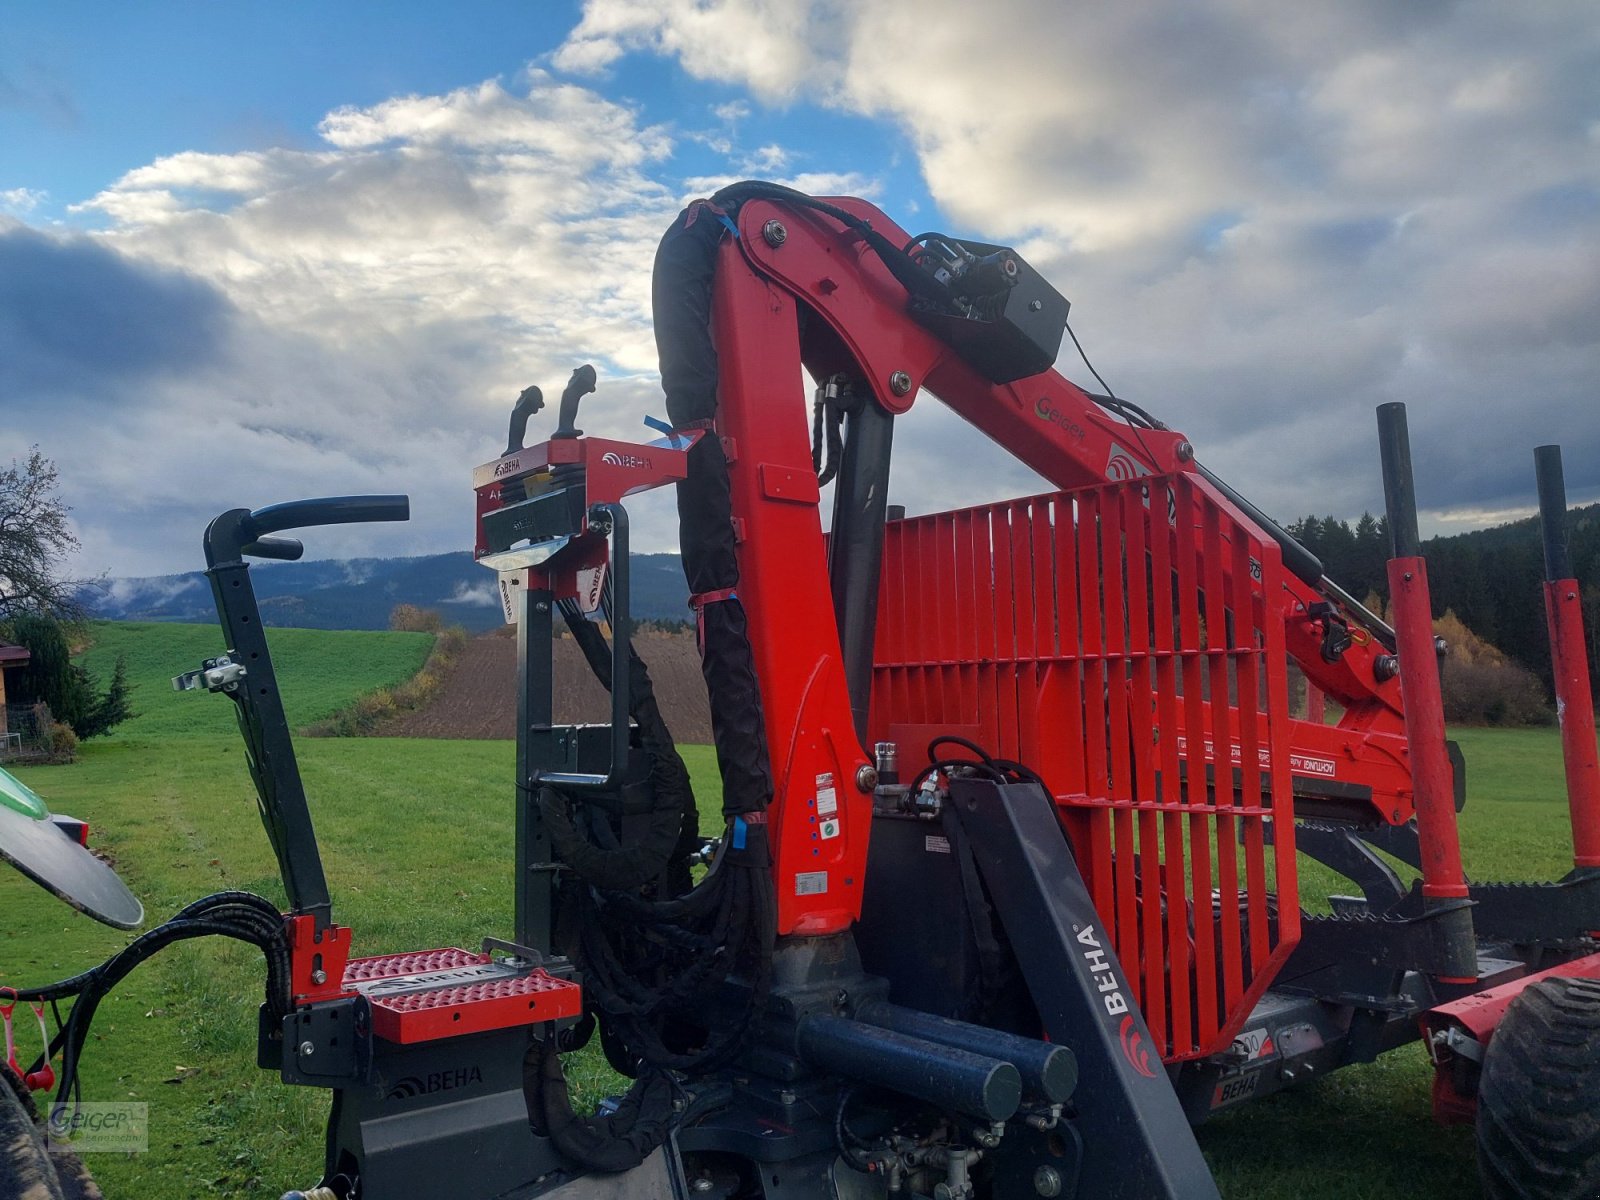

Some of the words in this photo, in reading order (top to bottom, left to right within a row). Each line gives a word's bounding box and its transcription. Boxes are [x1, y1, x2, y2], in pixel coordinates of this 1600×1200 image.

[505, 458, 521, 473] BEHA
[422, 968, 496, 983] BEHA
[427, 1065, 484, 1094] BEHA
[1221, 1075, 1256, 1102] BEHA
